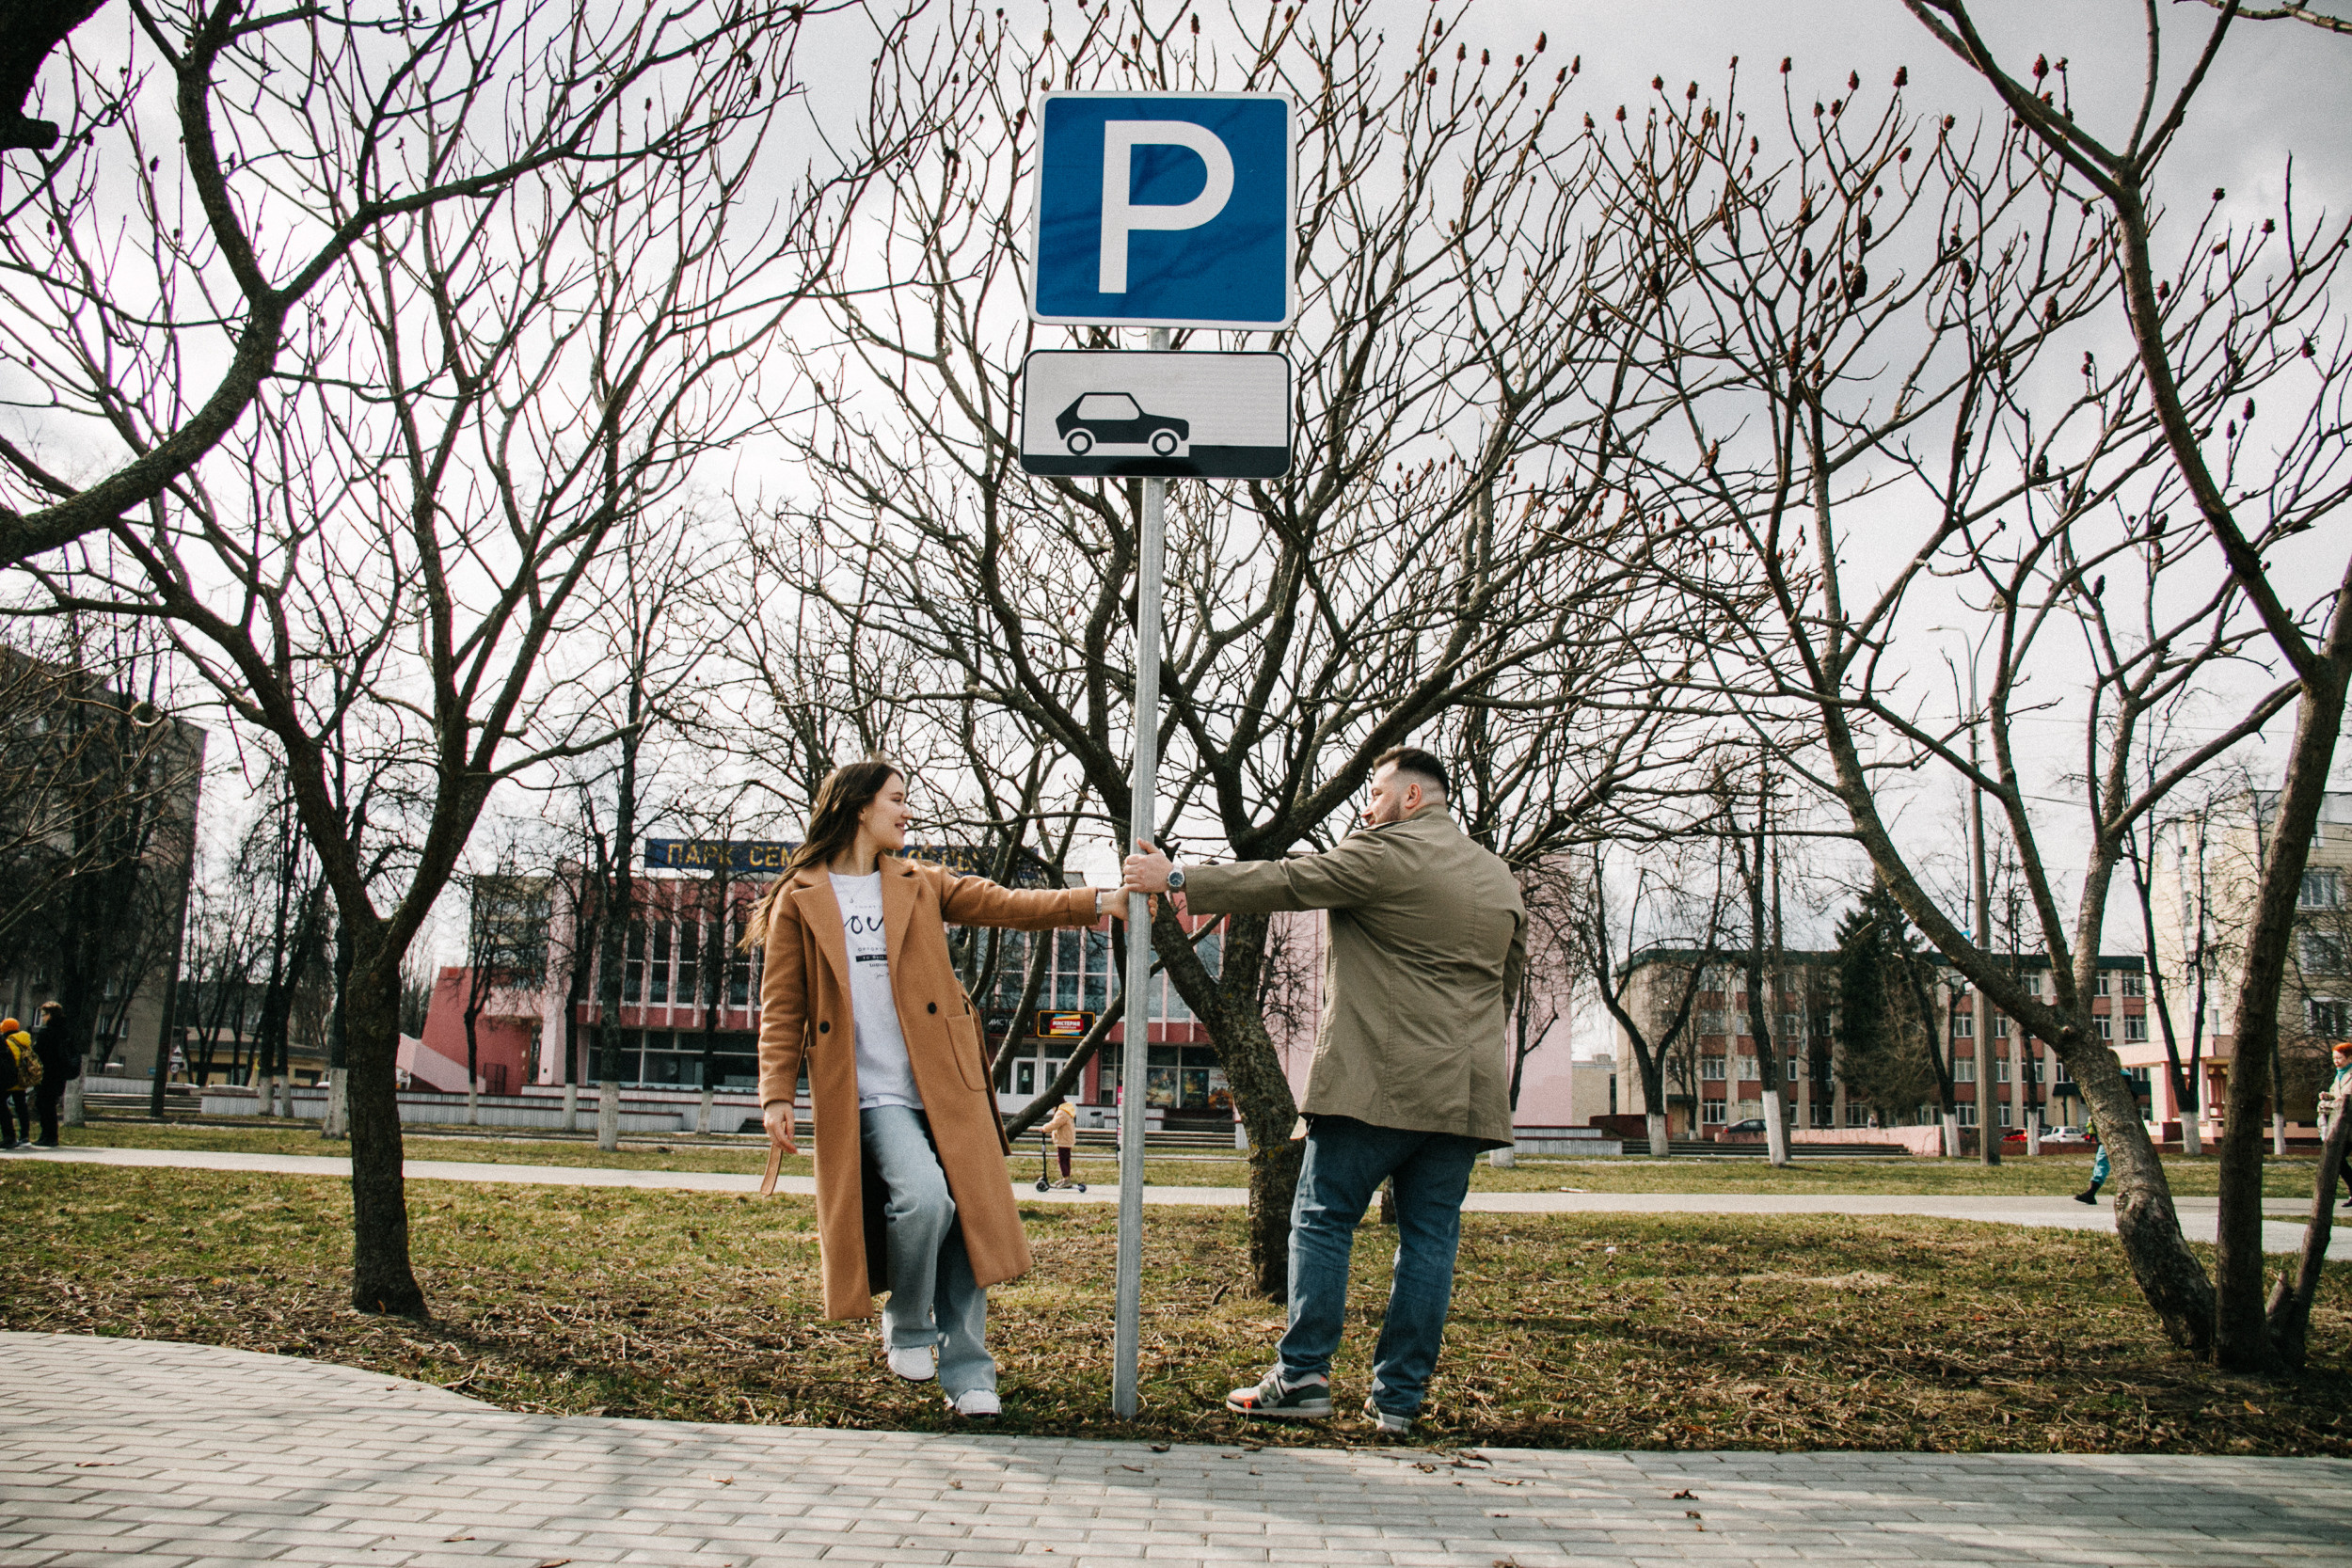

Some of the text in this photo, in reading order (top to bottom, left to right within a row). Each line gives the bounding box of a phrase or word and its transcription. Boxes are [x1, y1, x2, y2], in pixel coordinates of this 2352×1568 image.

[1099, 120, 1234, 293] P
[667, 844, 799, 867] ПАРК СЕМ
